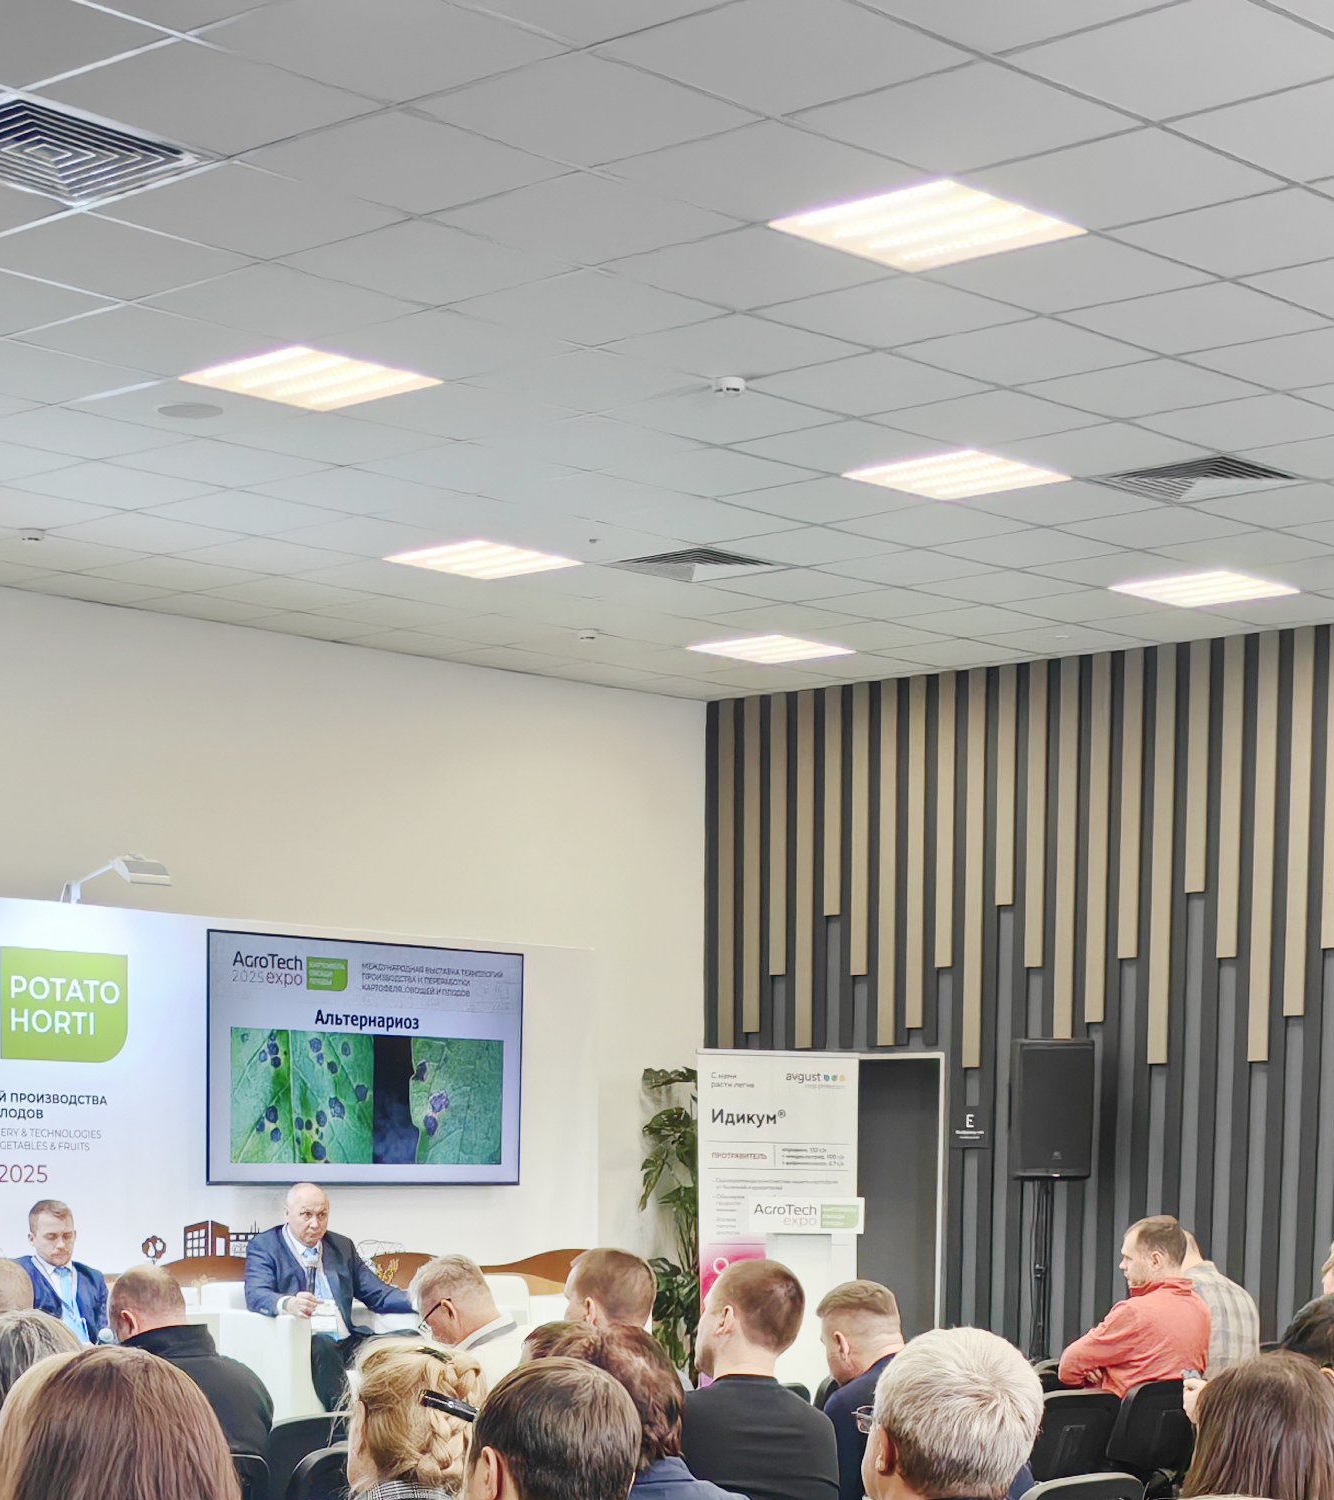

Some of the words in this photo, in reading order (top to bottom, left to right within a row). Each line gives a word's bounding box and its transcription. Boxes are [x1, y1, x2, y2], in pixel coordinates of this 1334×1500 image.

[233, 951, 303, 971] AgroTech
[266, 972, 303, 988] expo
[10, 976, 120, 1005] POTATO
[11, 1009, 96, 1035] HORTI
[315, 1009, 420, 1032] Альтернариоз
[786, 1073, 821, 1083] avgust
[11, 1093, 108, 1106] ПРОИЗВОДСТВА
[966, 1114, 974, 1128] E
[21, 1128, 27, 1138] &
[30, 1128, 102, 1139] TECHNOLOGIES
[50, 1141, 56, 1150] &
[58, 1141, 90, 1151] FRUITS
[754, 1203, 817, 1215] AgroTech
[783, 1216, 817, 1227] expo
